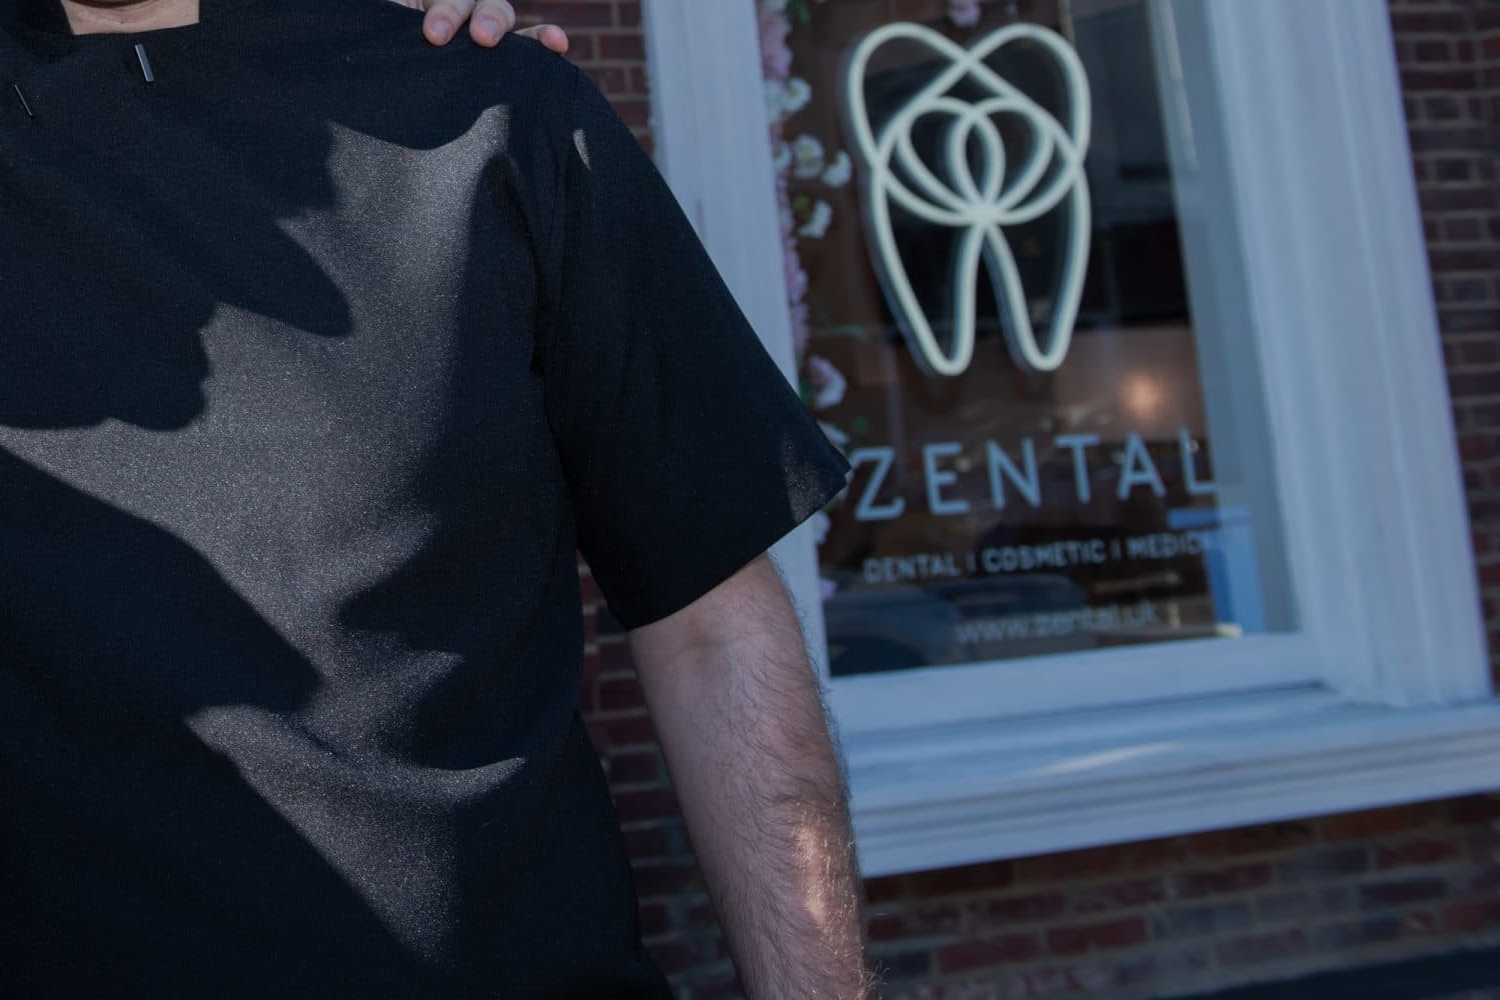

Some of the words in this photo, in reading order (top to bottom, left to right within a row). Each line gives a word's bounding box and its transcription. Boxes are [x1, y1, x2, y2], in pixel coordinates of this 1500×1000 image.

[852, 430, 1216, 520] ZENTAL
[864, 553, 959, 584] DENTAL
[982, 540, 1106, 573] COSMETIC
